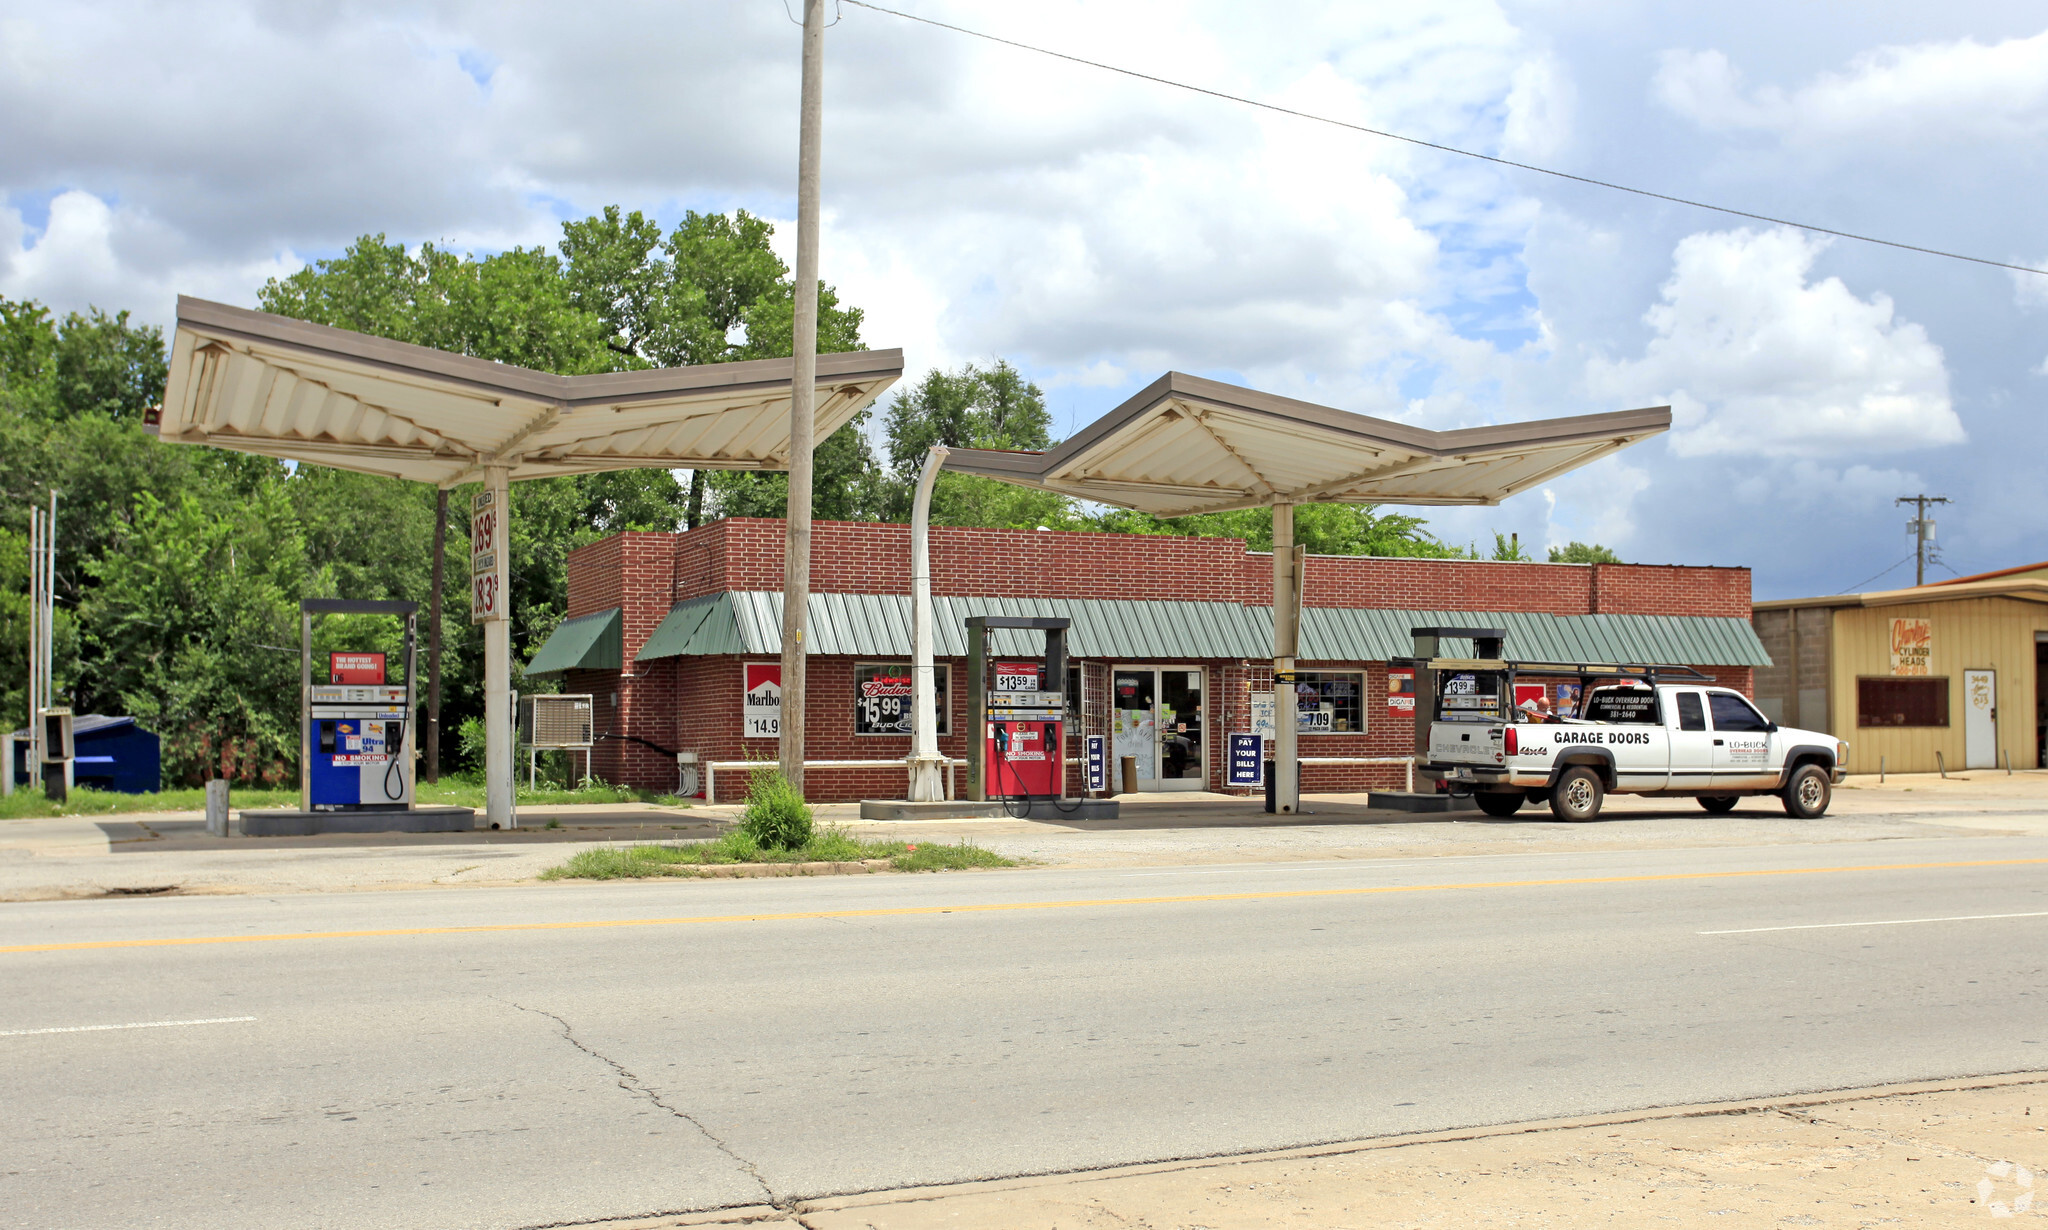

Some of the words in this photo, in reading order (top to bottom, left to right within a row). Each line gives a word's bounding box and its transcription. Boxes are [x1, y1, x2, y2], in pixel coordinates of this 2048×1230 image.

[1899, 647, 1930, 656] CYLINDER
[1900, 657, 1926, 666] HEADS
[747, 690, 781, 706] Marlbo
[1594, 696, 1614, 704] LO-BUCK
[1615, 696, 1640, 704] OVERHEAD
[1309, 713, 1329, 726] 7.09
[1554, 732, 1604, 744] GARAGE
[1609, 733, 1650, 744] DOORS
[1436, 744, 1495, 755] CHEVROLET
